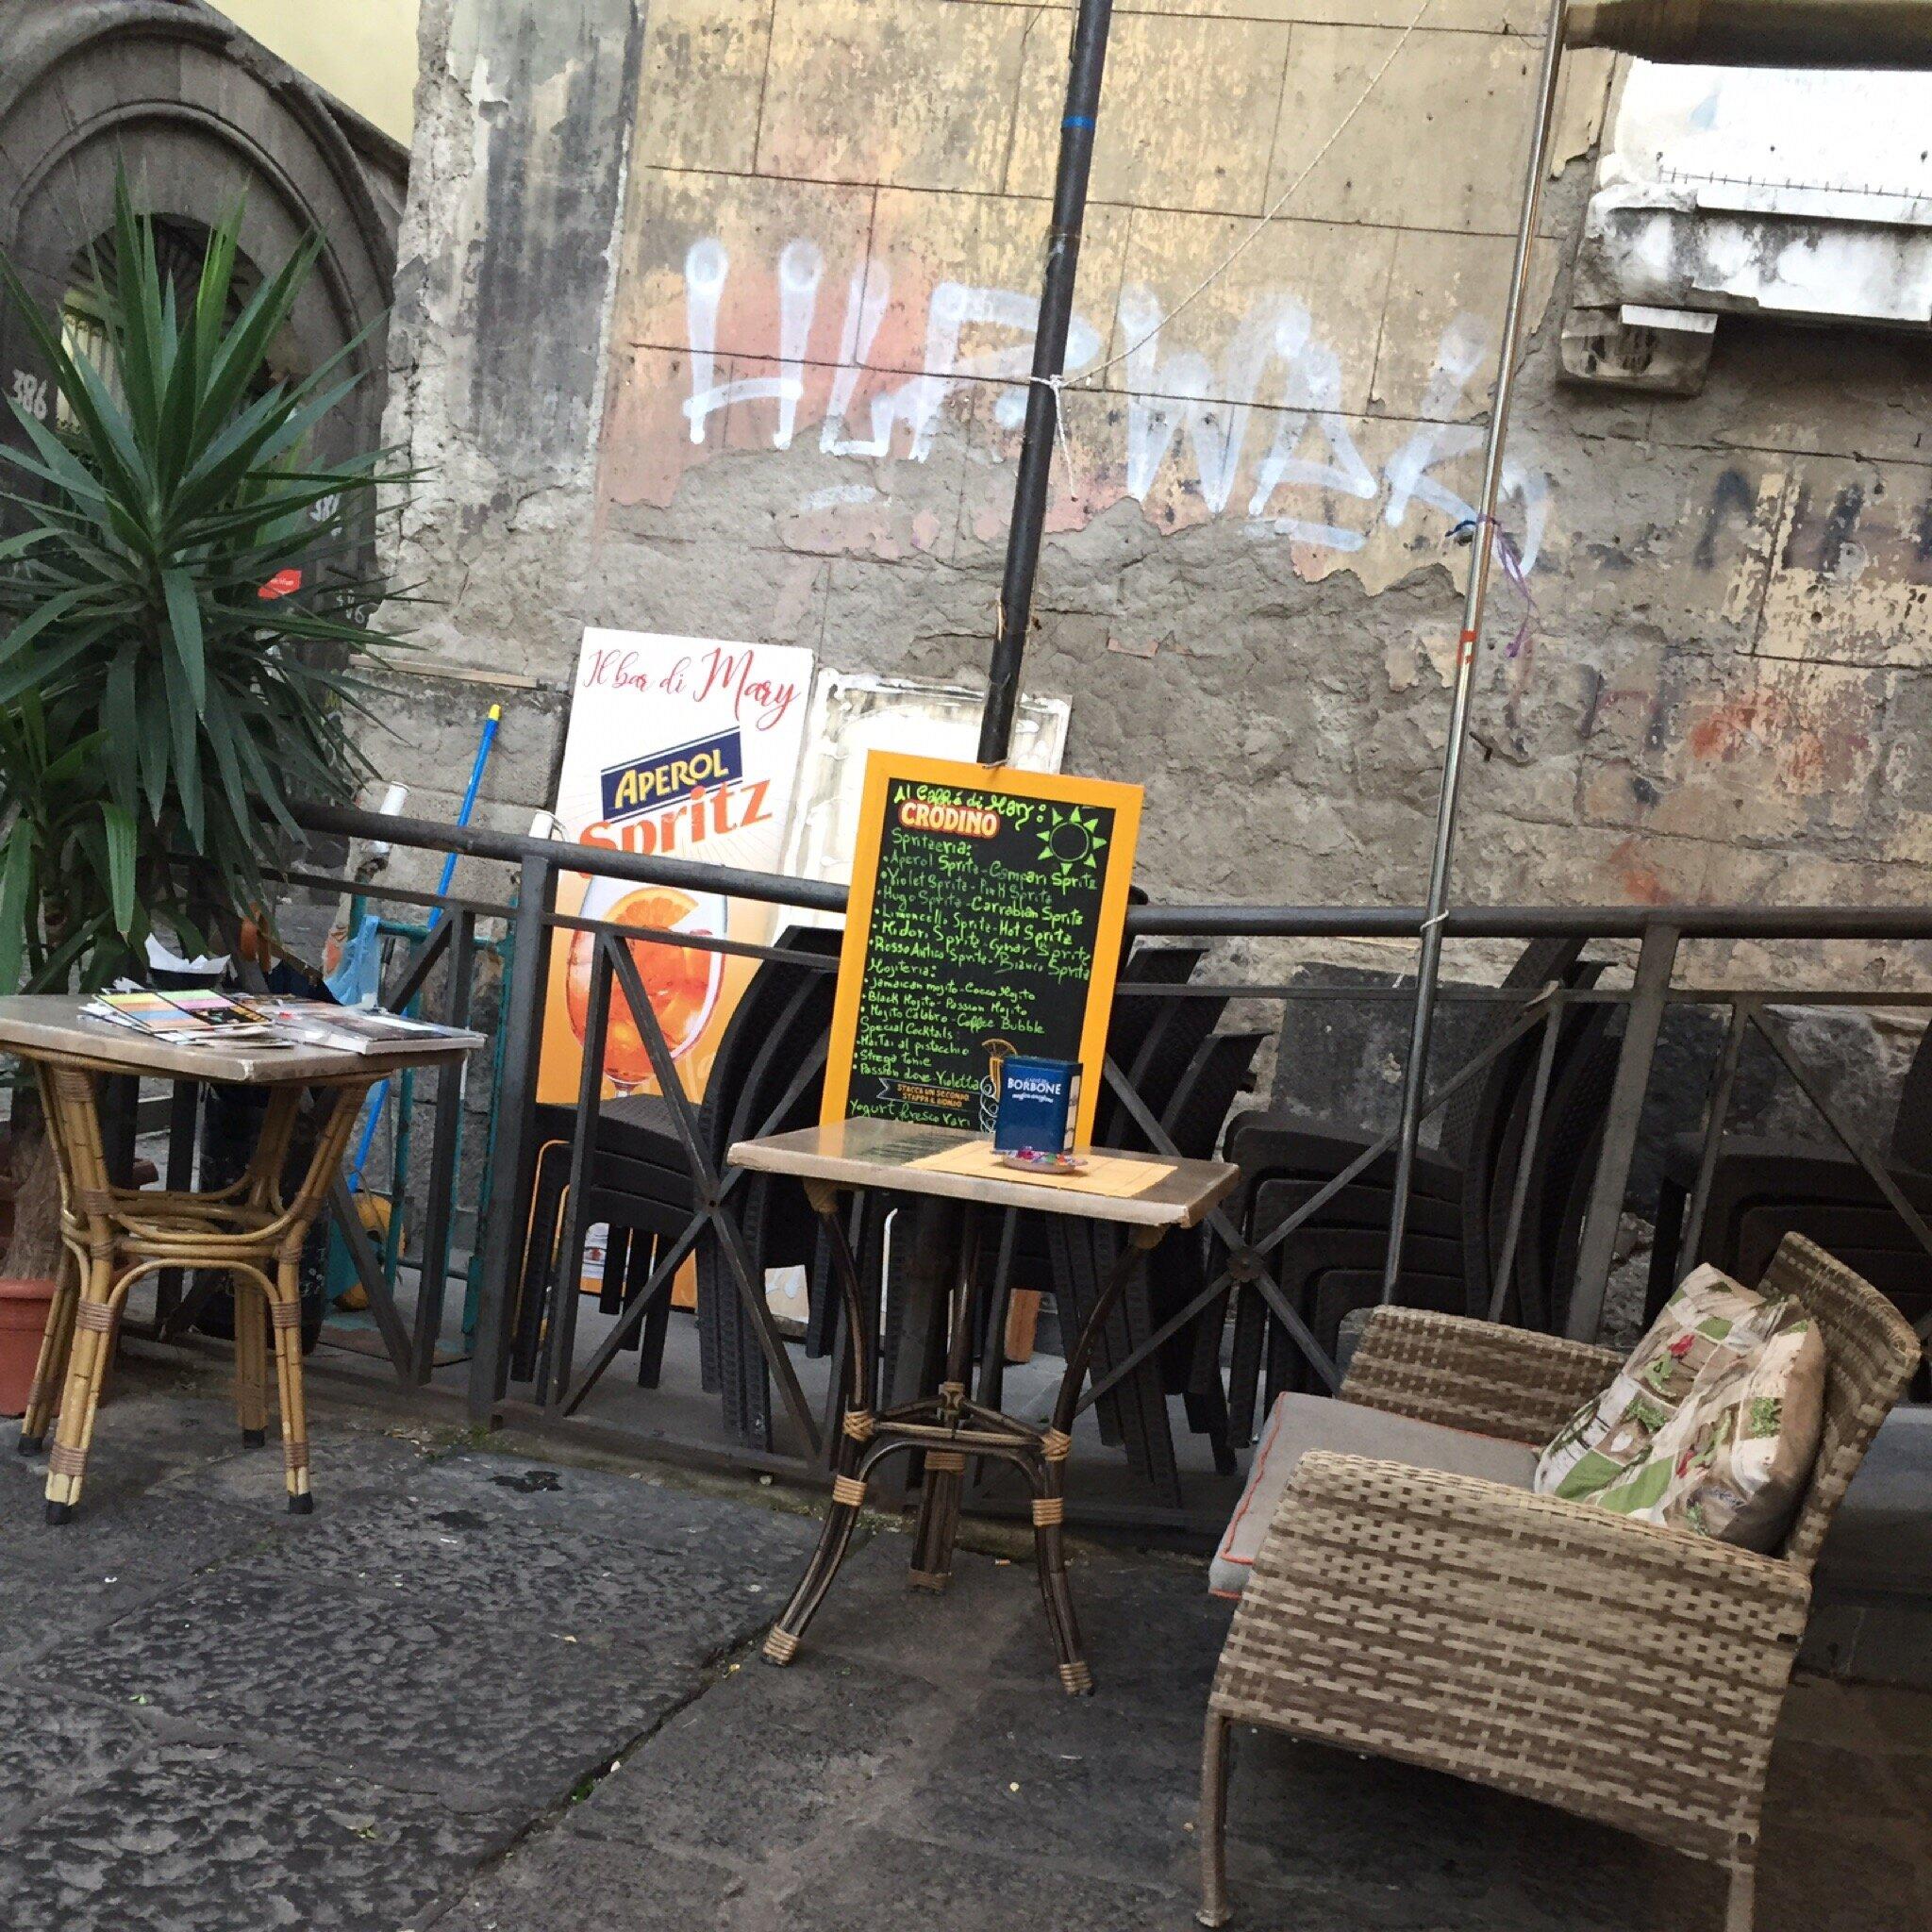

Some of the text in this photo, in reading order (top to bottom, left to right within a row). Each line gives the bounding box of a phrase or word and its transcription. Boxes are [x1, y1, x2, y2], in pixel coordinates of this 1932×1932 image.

[12, 369, 47, 421] 386
[613, 650, 651, 692] bar
[659, 657, 691, 694] di
[693, 647, 802, 731] Mary
[614, 748, 729, 809] APEROL
[966, 791, 983, 810] di
[901, 802, 997, 837] CRODINO
[890, 849, 1097, 895] Aperol Spritz Campari Spritz
[883, 885, 916, 911] Hugo
[918, 890, 961, 912] Spritz
[1041, 906, 1084, 929] Spritz
[927, 874, 967, 903] Spritz
[981, 877, 1006, 898] Pink
[1009, 884, 1052, 908] Spritz
[881, 919, 929, 940] Midori
[933, 924, 980, 954] Spritz
[1037, 942, 1091, 966] Spritz
[882, 903, 1074, 948] Limoncello Spritz Hot Spritz
[949, 947, 987, 967] Spritz
[1048, 958, 1091, 985] Spritz
[869, 976, 923, 991] Jamaican
[868, 990, 900, 1006] Black
[946, 996, 985, 1012] Passion
[859, 1015, 903, 1038] Special
[1001, 1018, 1045, 1034] Bubble
[915, 1040, 970, 1057] pistacchio
[859, 1063, 899, 1077] Passion
[1008, 1077, 1062, 1094] BORBONE
